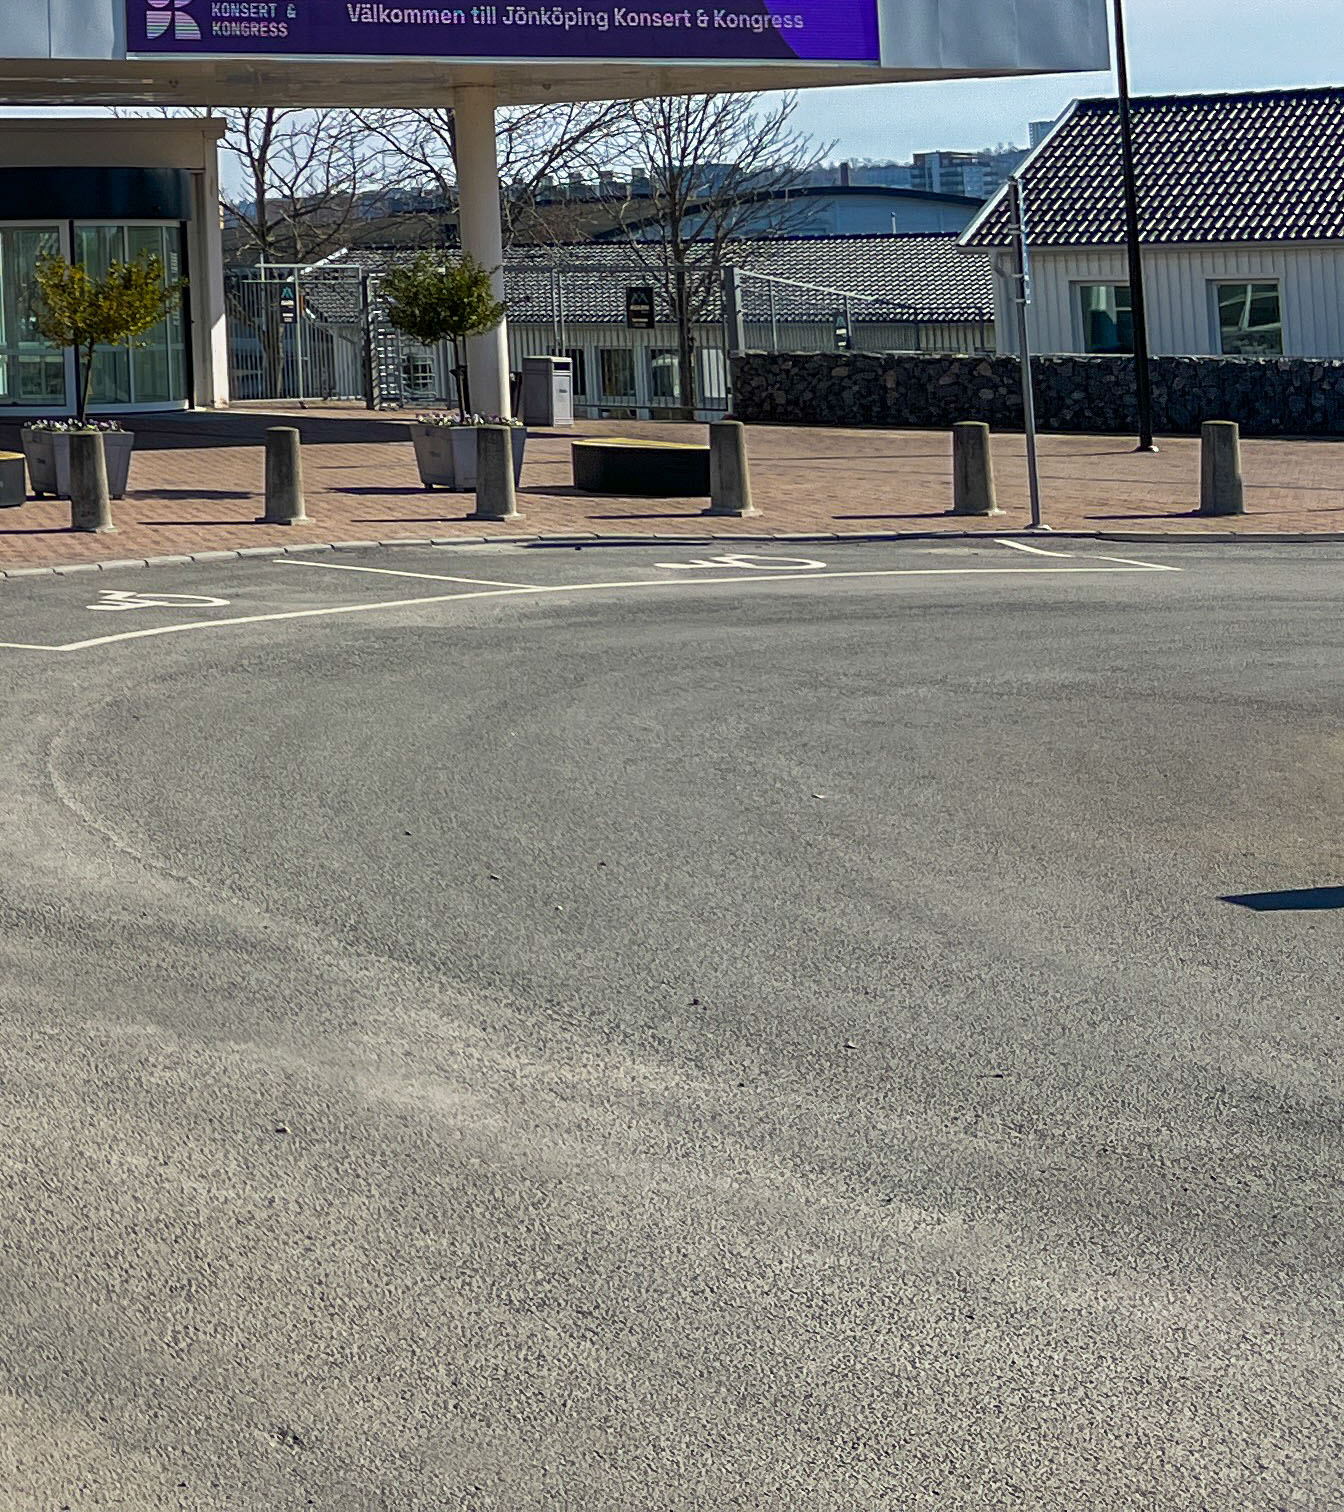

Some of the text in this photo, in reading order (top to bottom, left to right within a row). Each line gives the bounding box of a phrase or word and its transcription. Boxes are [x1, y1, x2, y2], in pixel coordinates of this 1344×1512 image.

[211, 2, 297, 19] KONSERT &
[346, 3, 804, 33] Välkommen till Jönköping Konsert & Kongress
[212, 21, 289, 38] KONGRESS
